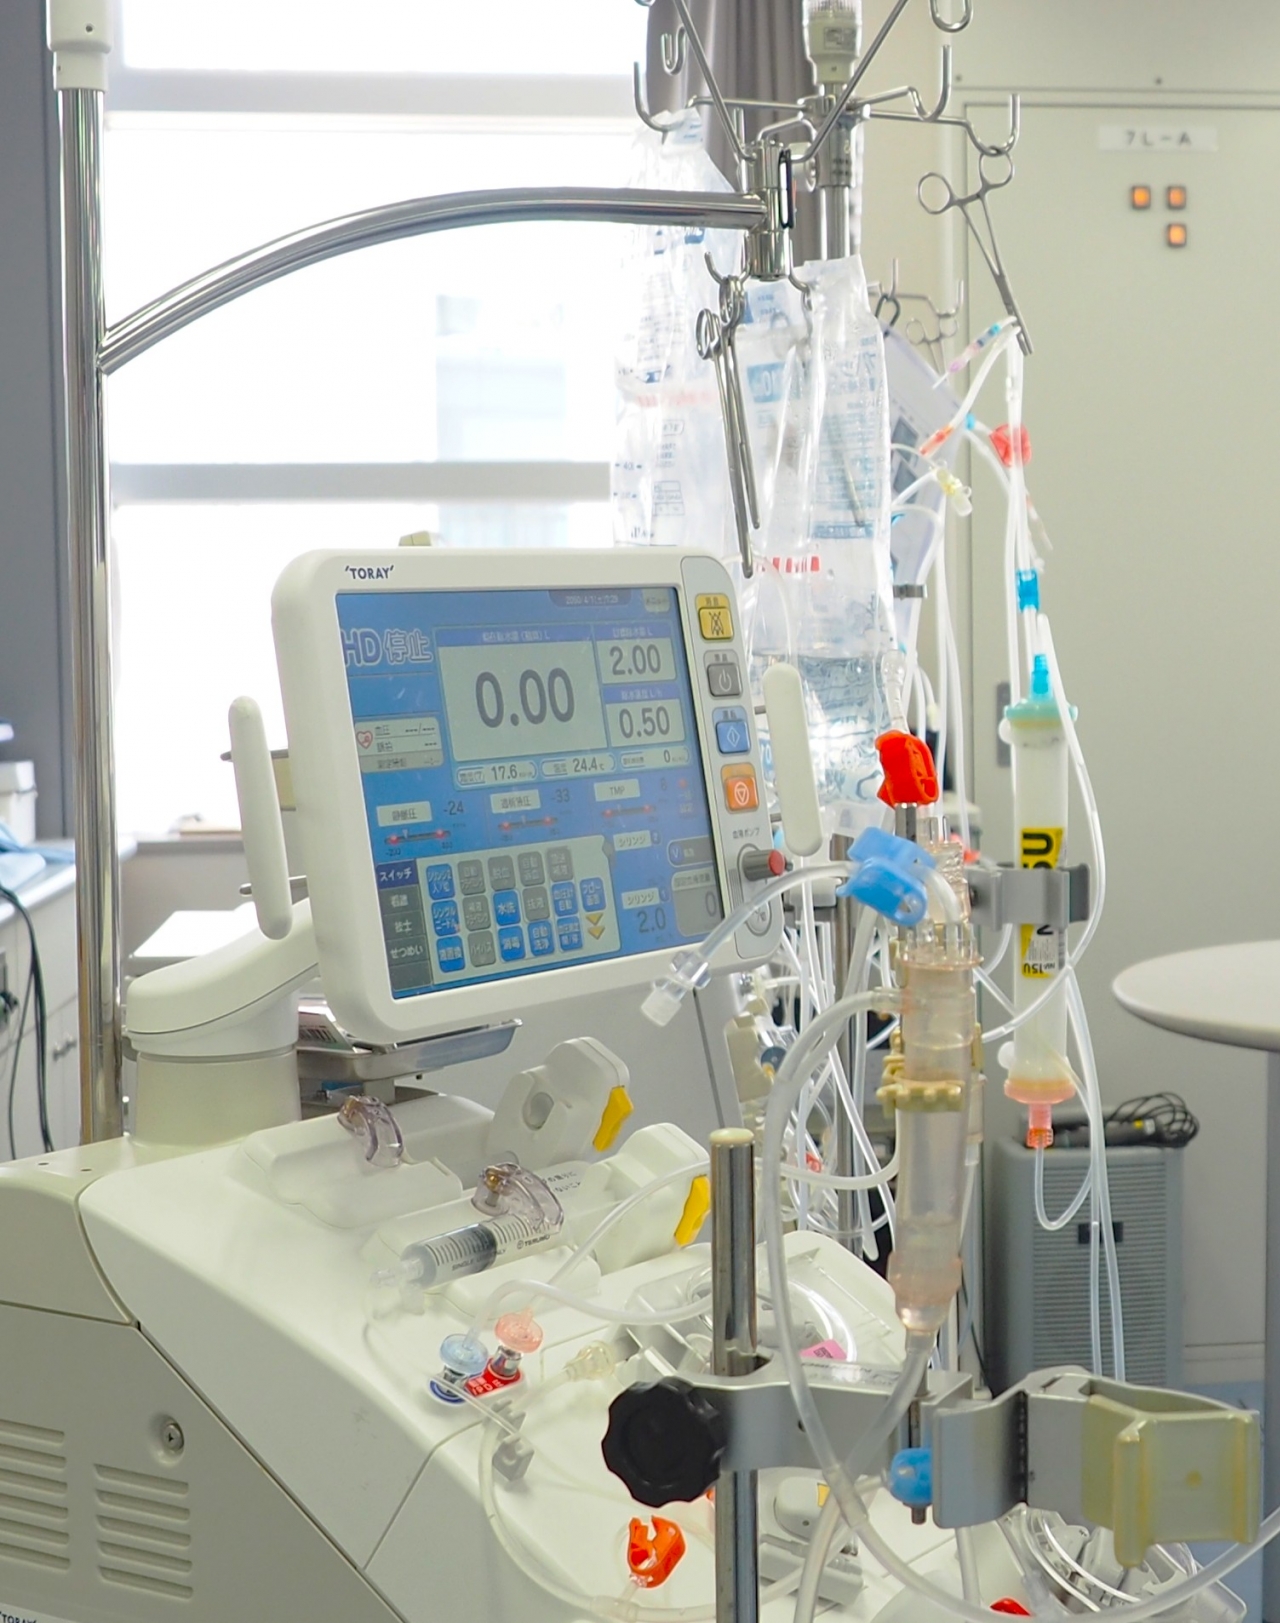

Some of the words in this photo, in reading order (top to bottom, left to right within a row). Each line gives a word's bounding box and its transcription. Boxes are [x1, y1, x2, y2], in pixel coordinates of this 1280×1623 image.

[609, 644, 662, 676] 2.00
[475, 666, 575, 729] 0.00
[618, 705, 671, 739] 0.50
[571, 756, 598, 773] 24.4
[663, 749, 671, 764] 0
[490, 763, 518, 781] 17.6
[608, 785, 626, 797] TMP
[443, 800, 465, 816] -24
[379, 867, 413, 882] スイッチ
[637, 906, 667, 934] 2.0
[389, 944, 424, 960] せつめい
